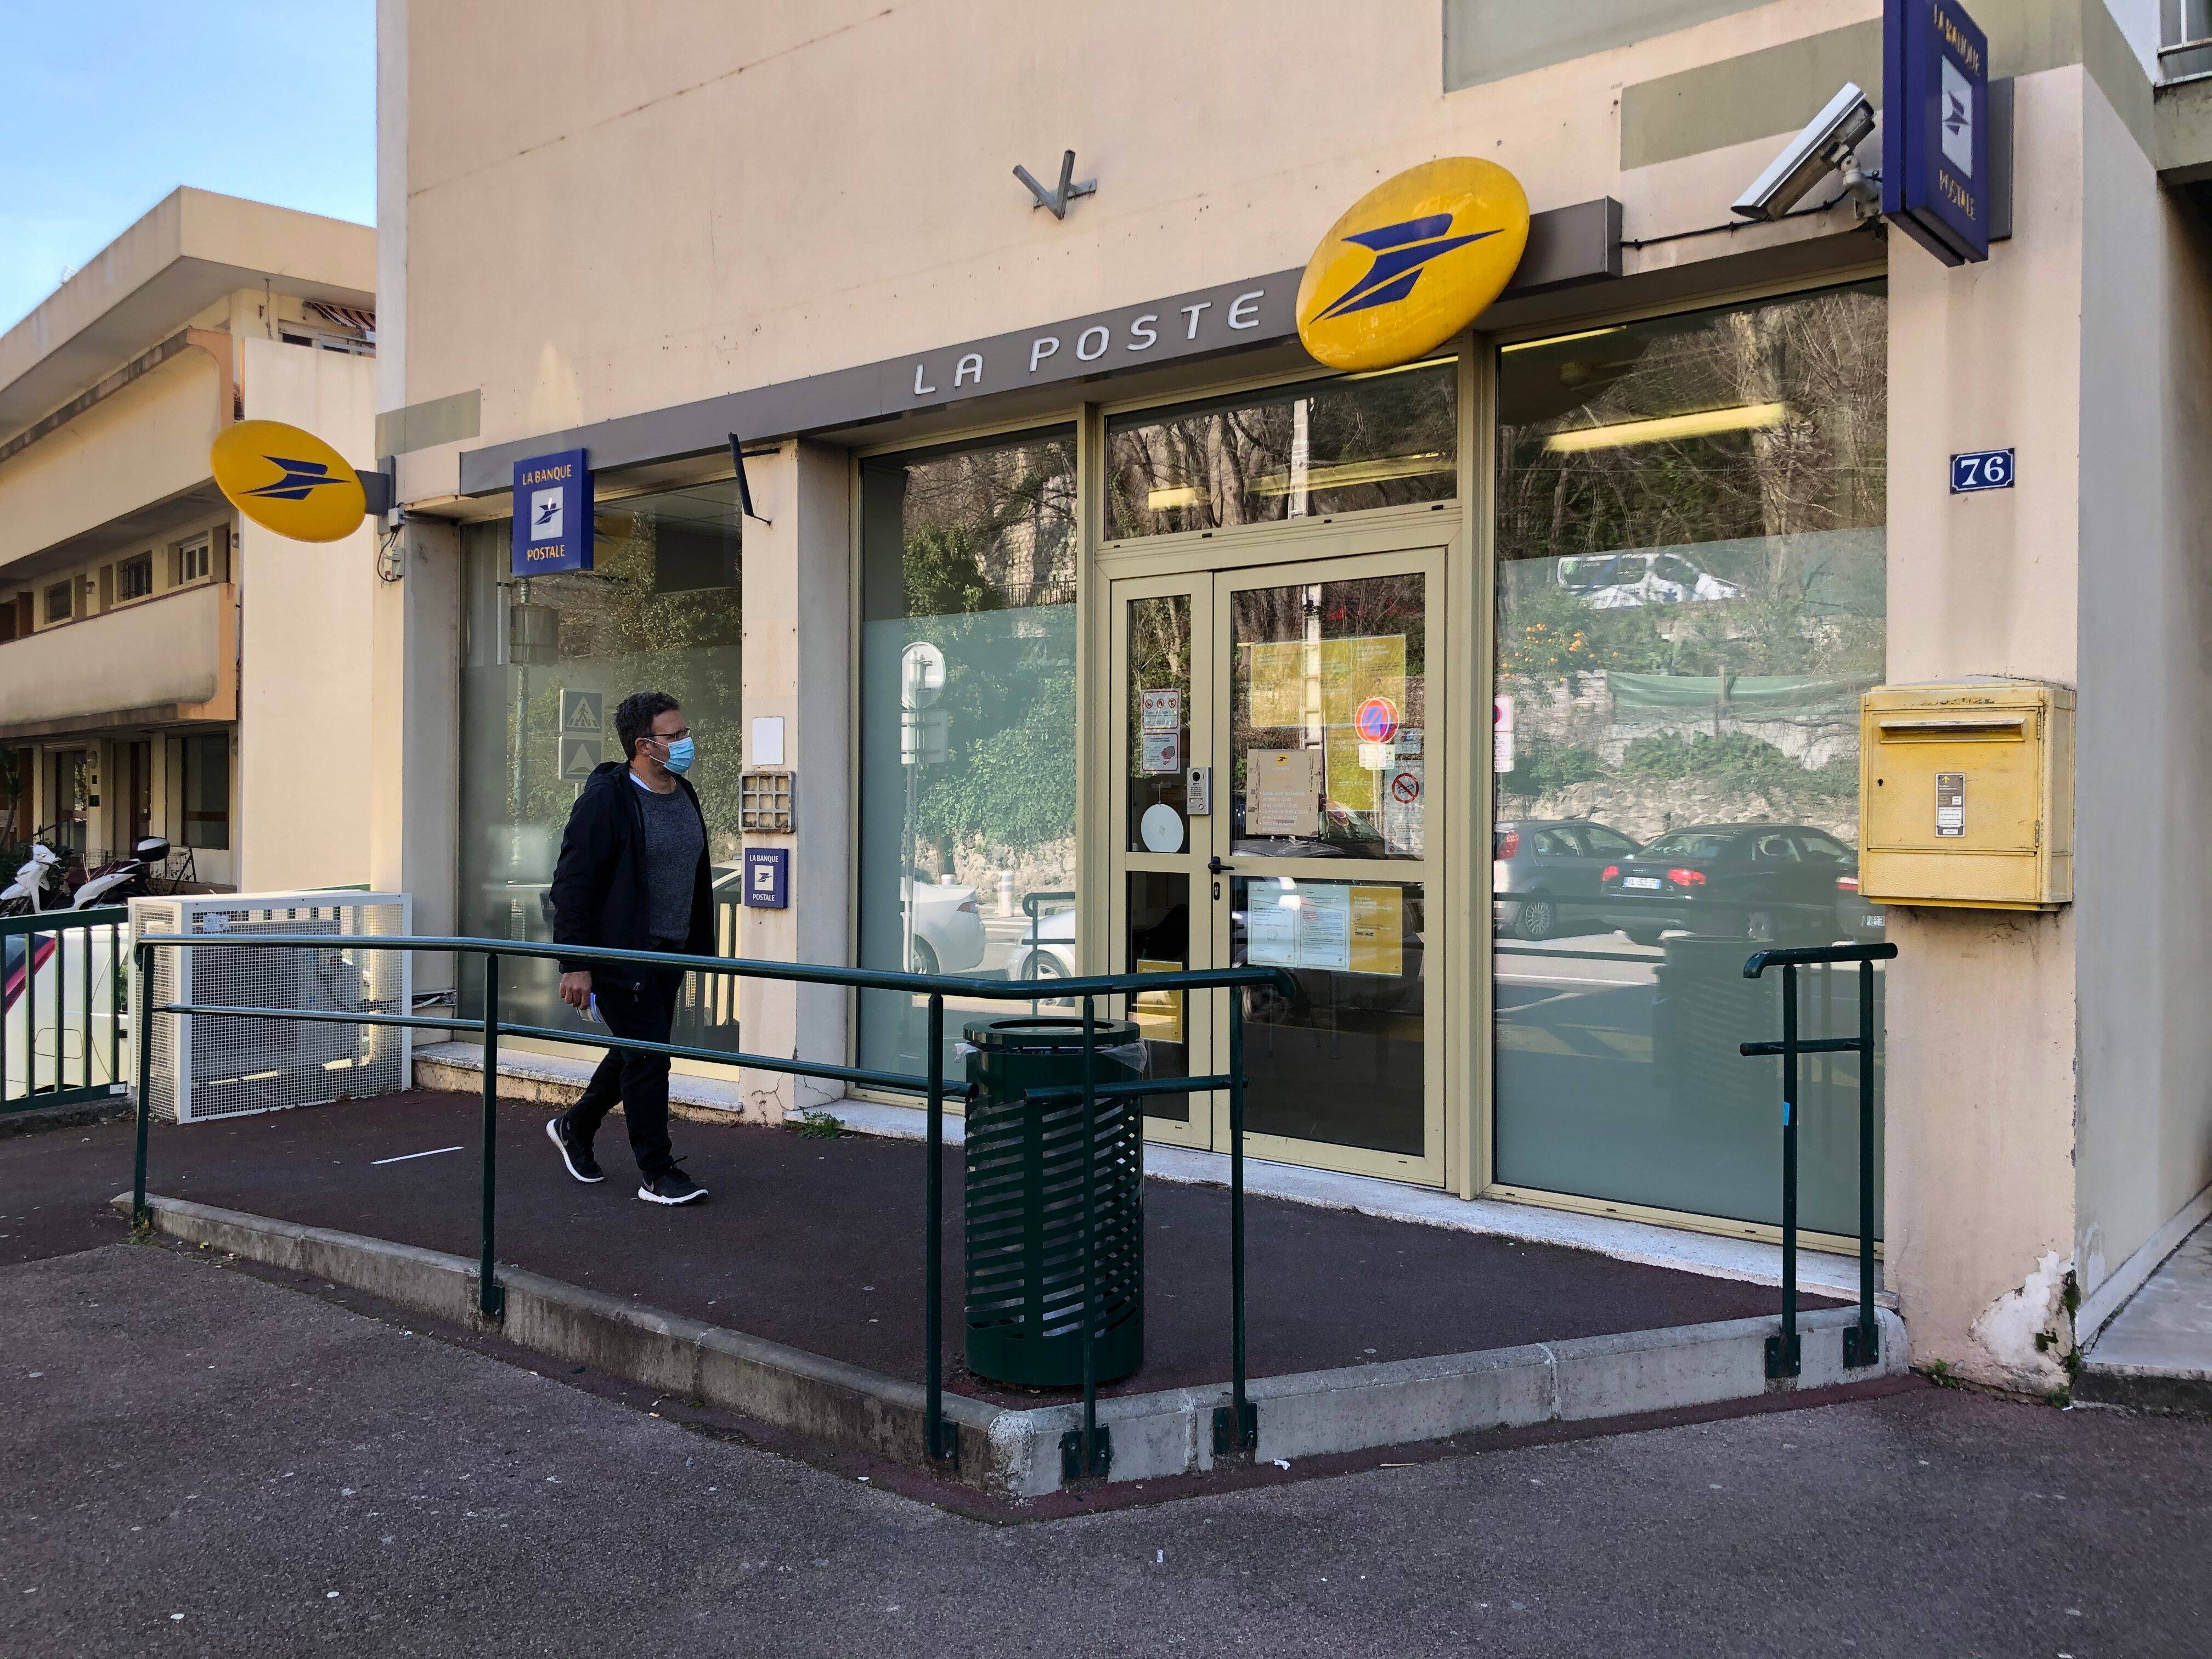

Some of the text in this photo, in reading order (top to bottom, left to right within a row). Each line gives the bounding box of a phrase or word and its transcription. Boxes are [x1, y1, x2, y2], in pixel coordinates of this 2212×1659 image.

[913, 290, 1265, 394] LA POSTE
[522, 465, 572, 486] LA BANQUE
[1960, 456, 2005, 486] 76
[527, 545, 565, 562] POSTALE
[757, 855, 779, 863] BANQUE
[752, 893, 775, 901] POSTALE
